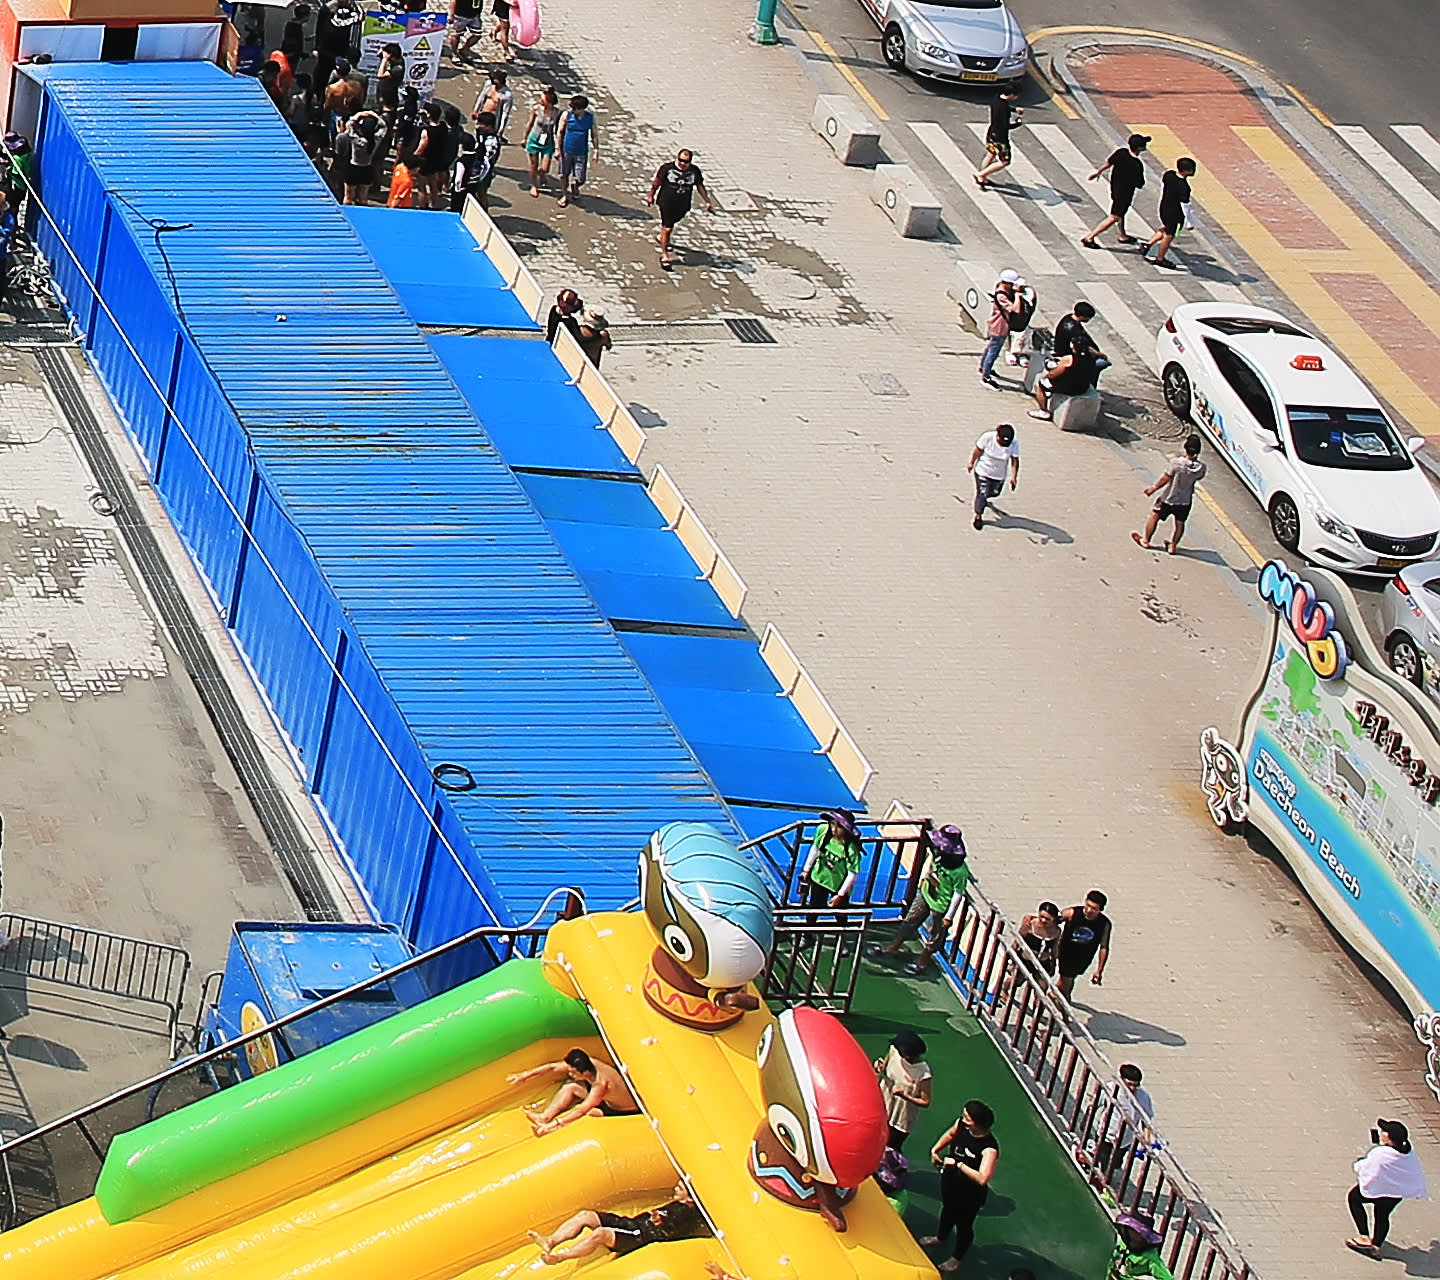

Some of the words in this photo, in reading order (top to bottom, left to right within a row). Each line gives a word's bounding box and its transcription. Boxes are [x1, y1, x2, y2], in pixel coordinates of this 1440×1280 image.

[1258, 559, 1347, 680] MUD
[1253, 758, 1317, 845] Daecheon
[1319, 838, 1362, 900] Beach
